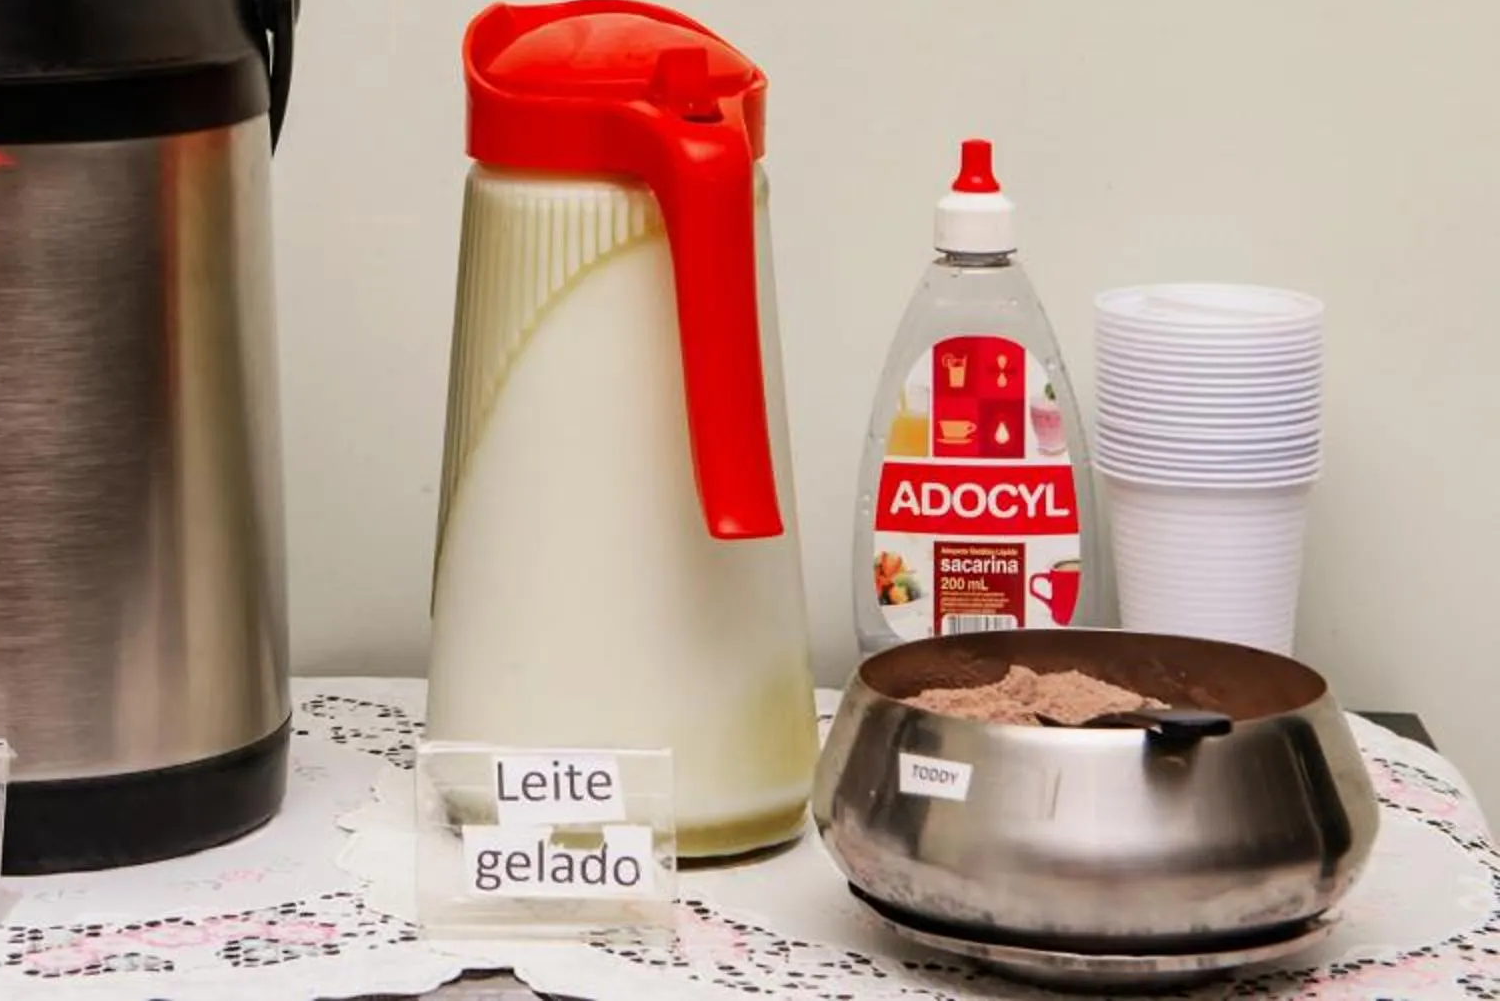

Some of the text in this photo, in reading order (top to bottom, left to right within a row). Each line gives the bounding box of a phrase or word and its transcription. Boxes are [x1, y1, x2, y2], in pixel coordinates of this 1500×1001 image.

[890, 480, 1071, 519] ADOCYL
[940, 554, 1020, 575] sacarina
[940, 576, 990, 592] 200 mL
[497, 759, 613, 802] Leite
[912, 763, 960, 786] TODDY
[474, 839, 642, 892] gelado
